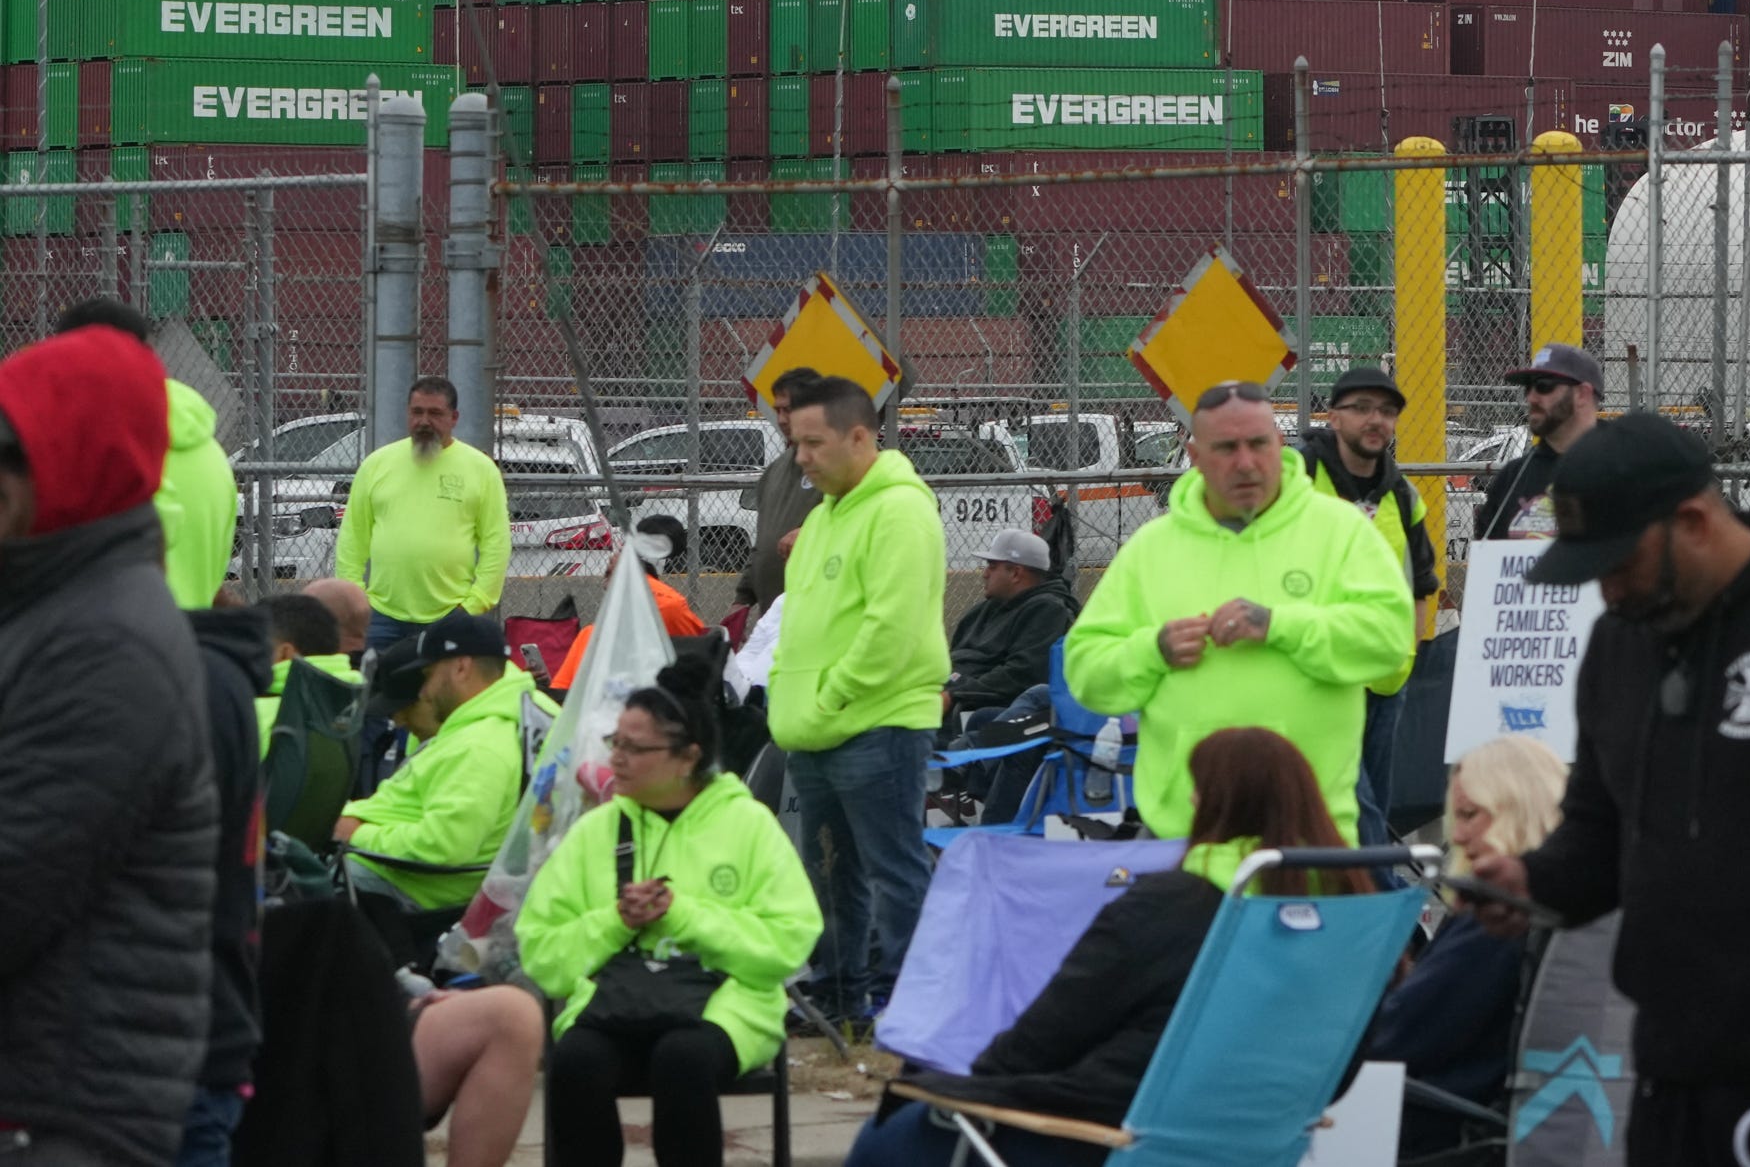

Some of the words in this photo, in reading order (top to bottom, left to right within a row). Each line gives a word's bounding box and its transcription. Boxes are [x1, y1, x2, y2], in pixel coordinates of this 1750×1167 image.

[161, 0, 392, 38] EVERGREEN
[994, 13, 1158, 40] EVERGREEN
[1602, 50, 1634, 69] ZIM
[192, 85, 424, 120] EVERGRE
[1012, 93, 1224, 126] EVERGREEN
[1575, 113, 1600, 134] he
[957, 498, 1009, 524] 9261
[1497, 609, 1570, 633] FAMILIES:
[1482, 638, 1550, 660] SUPPORT
[1553, 637, 1577, 659] ILA
[1490, 664, 1565, 688] WORKERS
